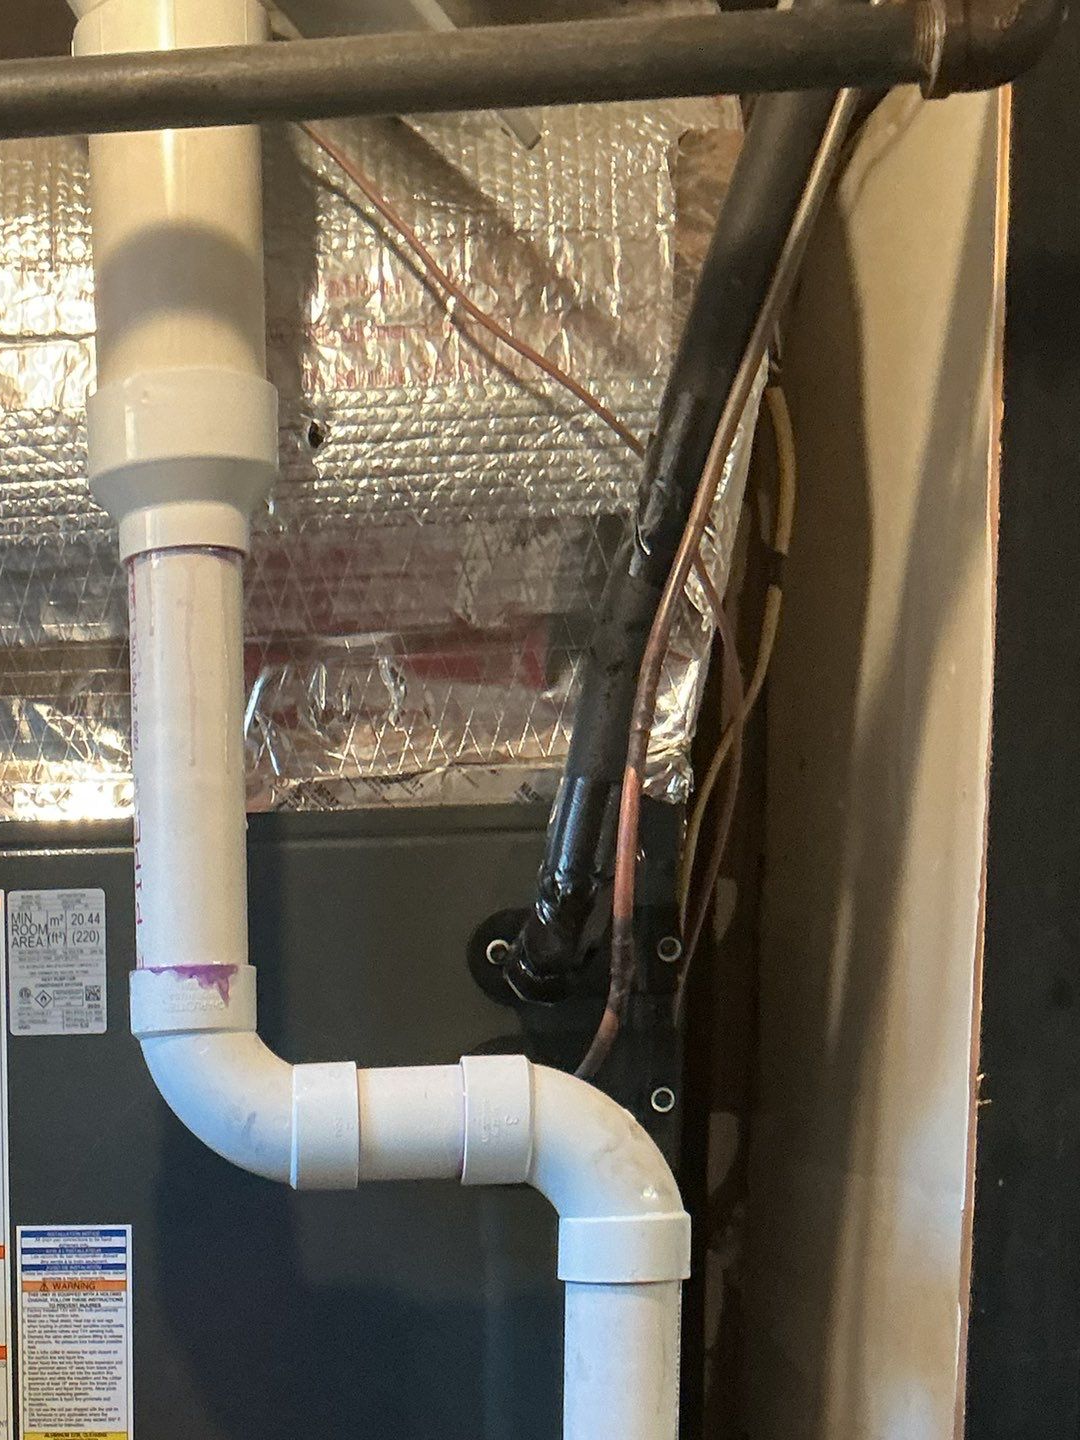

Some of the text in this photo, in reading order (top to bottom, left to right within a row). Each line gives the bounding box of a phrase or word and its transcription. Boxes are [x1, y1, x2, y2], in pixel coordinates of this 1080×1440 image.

[12, 913, 32, 924] MIN
[12, 924, 48, 935] ROOM
[72, 930, 99, 945] (220)
[52, 1282, 95, 1290] WARNING
